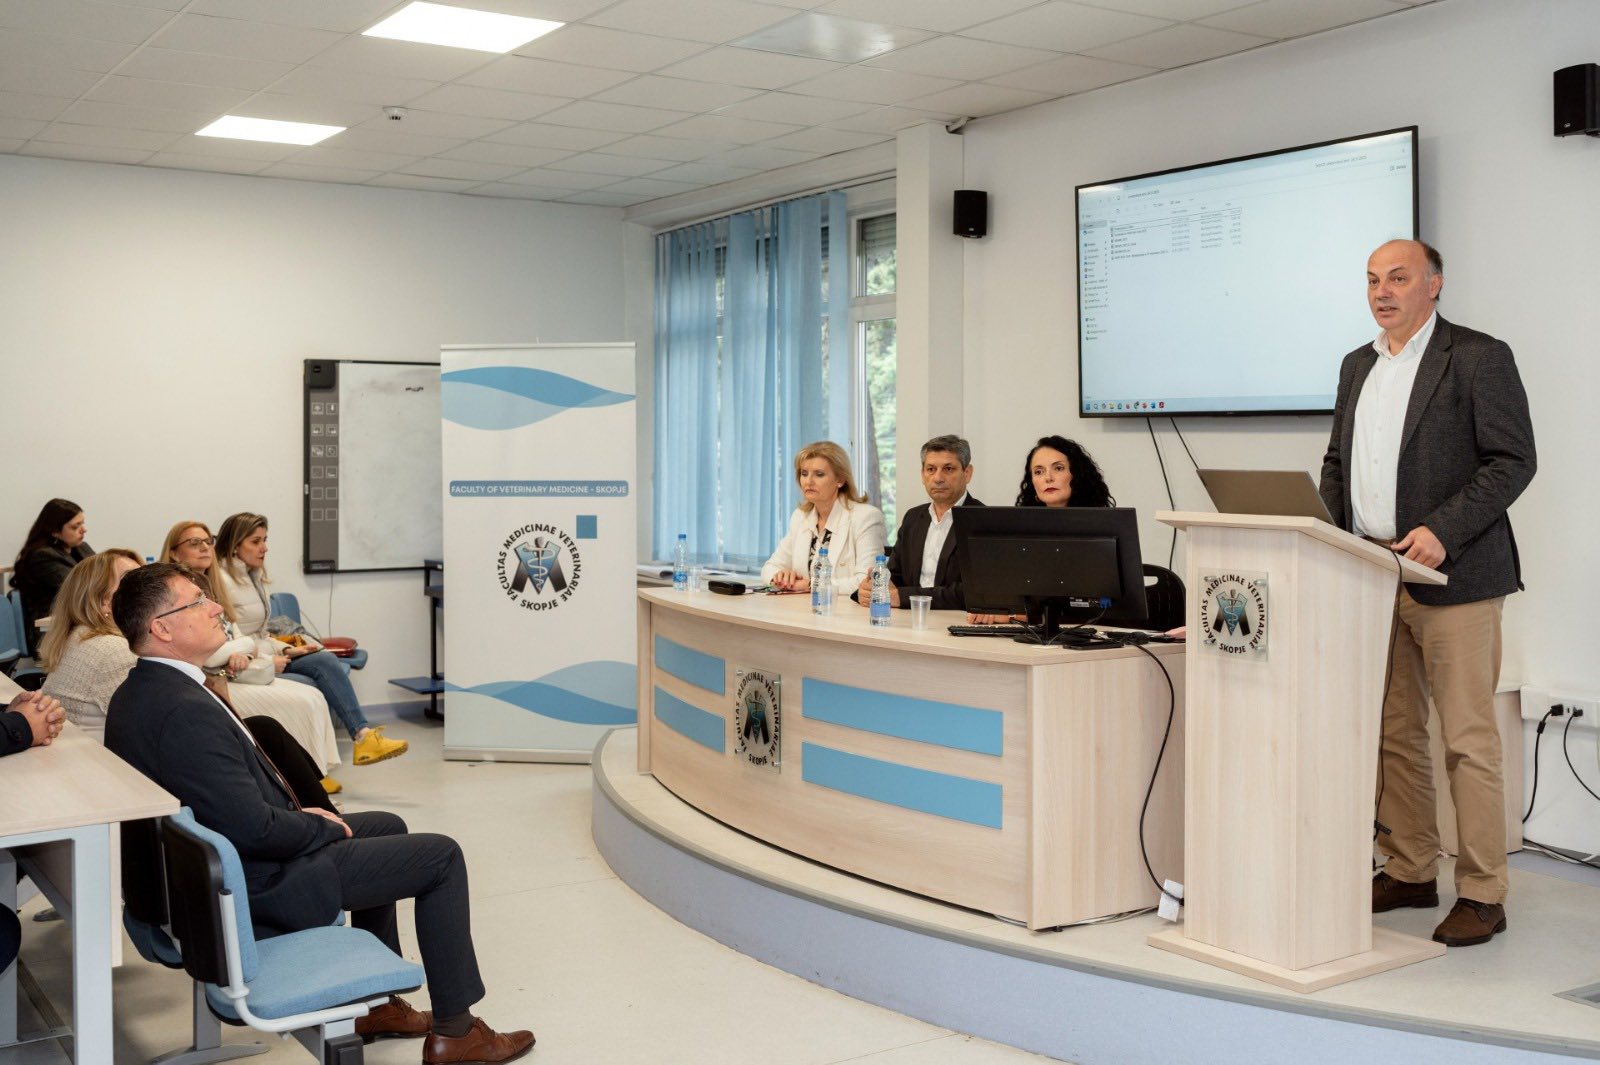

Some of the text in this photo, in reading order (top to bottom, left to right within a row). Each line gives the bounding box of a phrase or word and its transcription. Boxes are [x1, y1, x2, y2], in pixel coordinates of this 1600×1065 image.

[451, 485, 485, 493] FACULTY
[487, 485, 498, 493] OF
[500, 485, 547, 493] VETERINARY
[549, 485, 588, 493] MEDICINE
[596, 485, 627, 493] SKOPJE
[497, 523, 581, 602] FACULTAS MEDICINAE VETERINARIAE
[520, 599, 559, 611] SKOPJE
[1201, 574, 1265, 649] FACULTAS MEDICINAE VETERINARIAE
[1219, 643, 1246, 653] SKOPJE
[737, 672, 764, 698] MEDICINAE
[748, 753, 768, 765] SKOPJE
